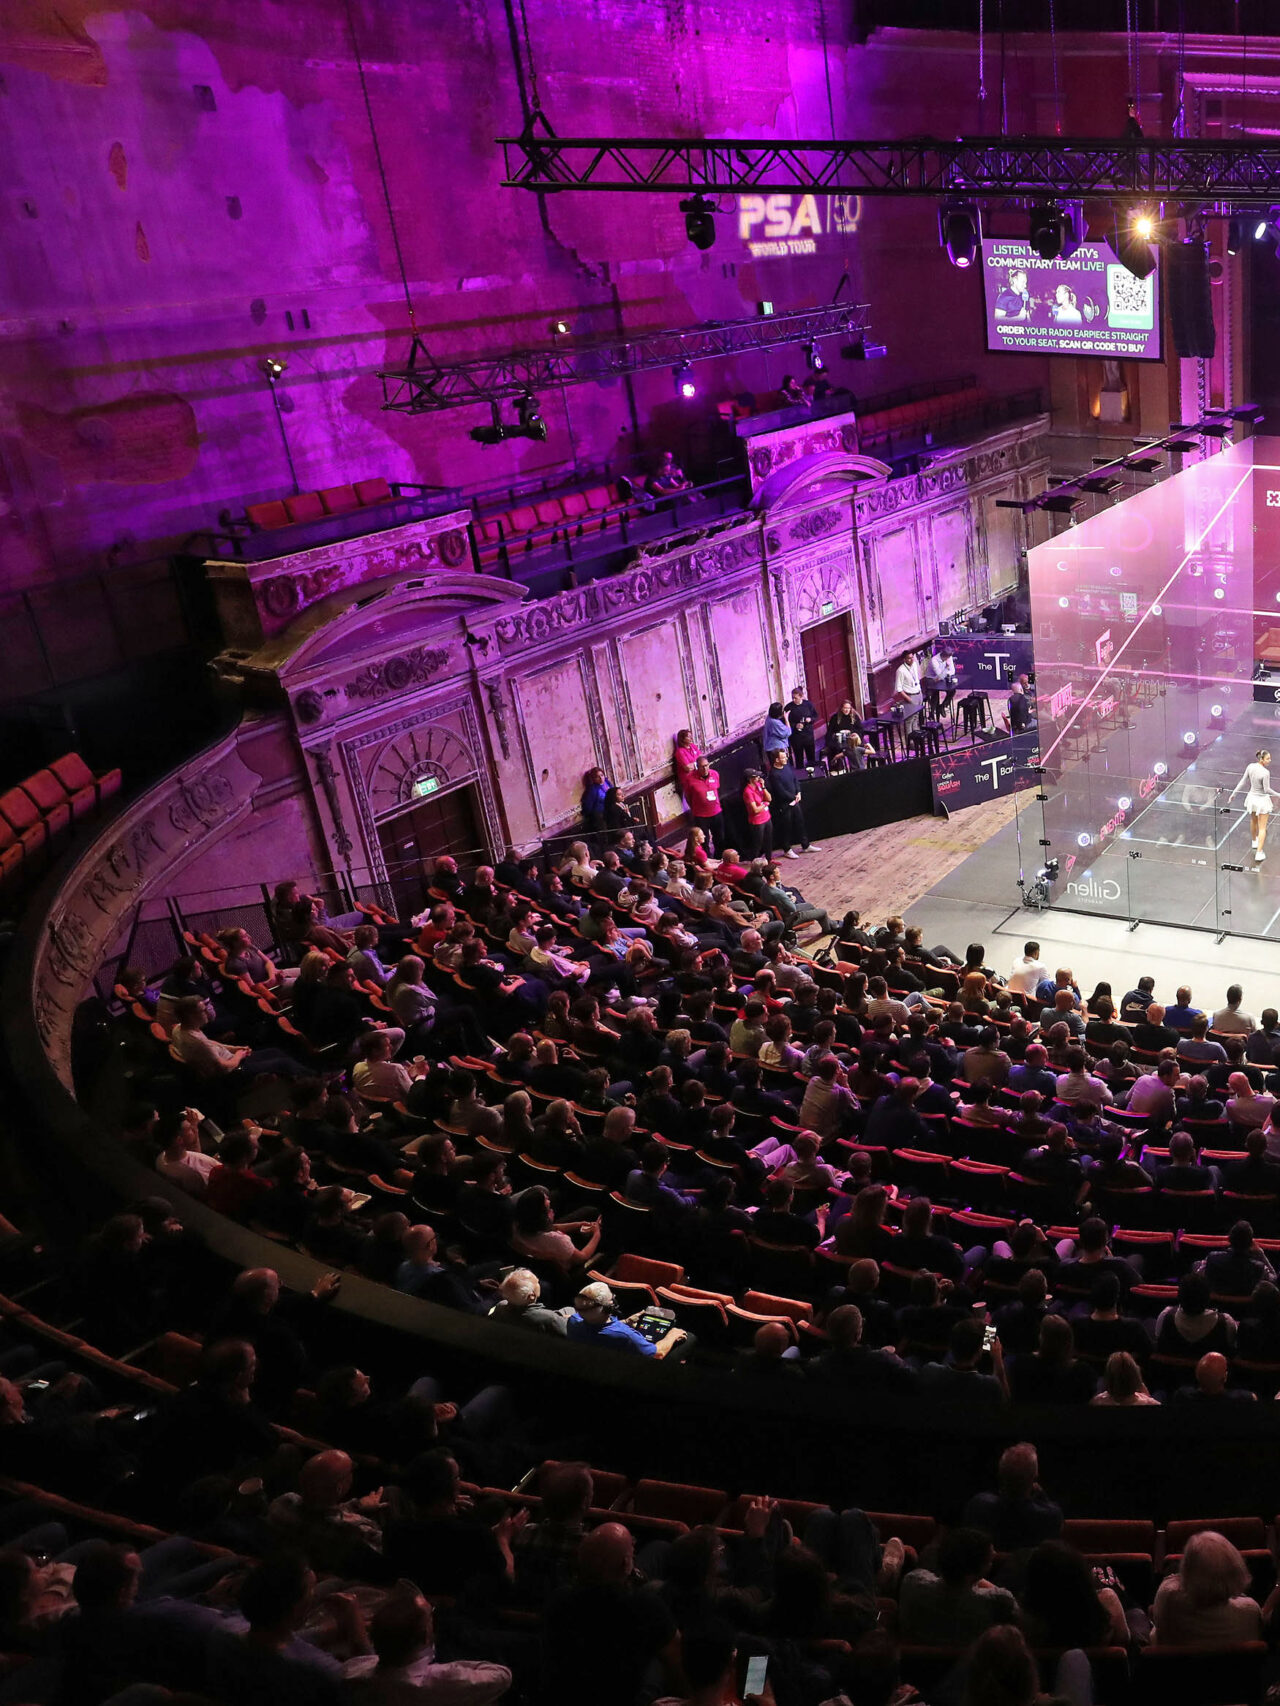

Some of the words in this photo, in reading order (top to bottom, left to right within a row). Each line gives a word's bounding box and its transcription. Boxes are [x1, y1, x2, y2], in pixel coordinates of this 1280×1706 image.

[739, 194, 822, 239] PSA
[993, 244, 1026, 256] LISTEN
[987, 257, 1053, 269] COMMENTARY
[1055, 260, 1080, 270] TEAM
[1082, 261, 1104, 271] LIVE!
[997, 325, 1024, 335] ORDER
[1025, 326, 1048, 336] YOUR
[1049, 328, 1073, 337] RADIO
[1074, 329, 1110, 340] EARPIECE
[1111, 331, 1149, 342] STRAIGHT
[1002, 336, 1014, 344] TO
[1014, 337, 1037, 346] YOUR
[1038, 338, 1058, 348] SEAT,
[1059, 340, 1082, 349] SCAN
[1082, 340, 1094, 350] QR
[1094, 341, 1116, 351] CODE
[1116, 342, 1128, 352] TO
[1128, 343, 1145, 352] BUY
[978, 662, 992, 670] The
[984, 653, 1010, 680] T
[1003, 662, 1016, 671] Bar
[981, 754, 1008, 790] T
[1000, 766, 1014, 776] Bar
[974, 774, 990, 784] The
